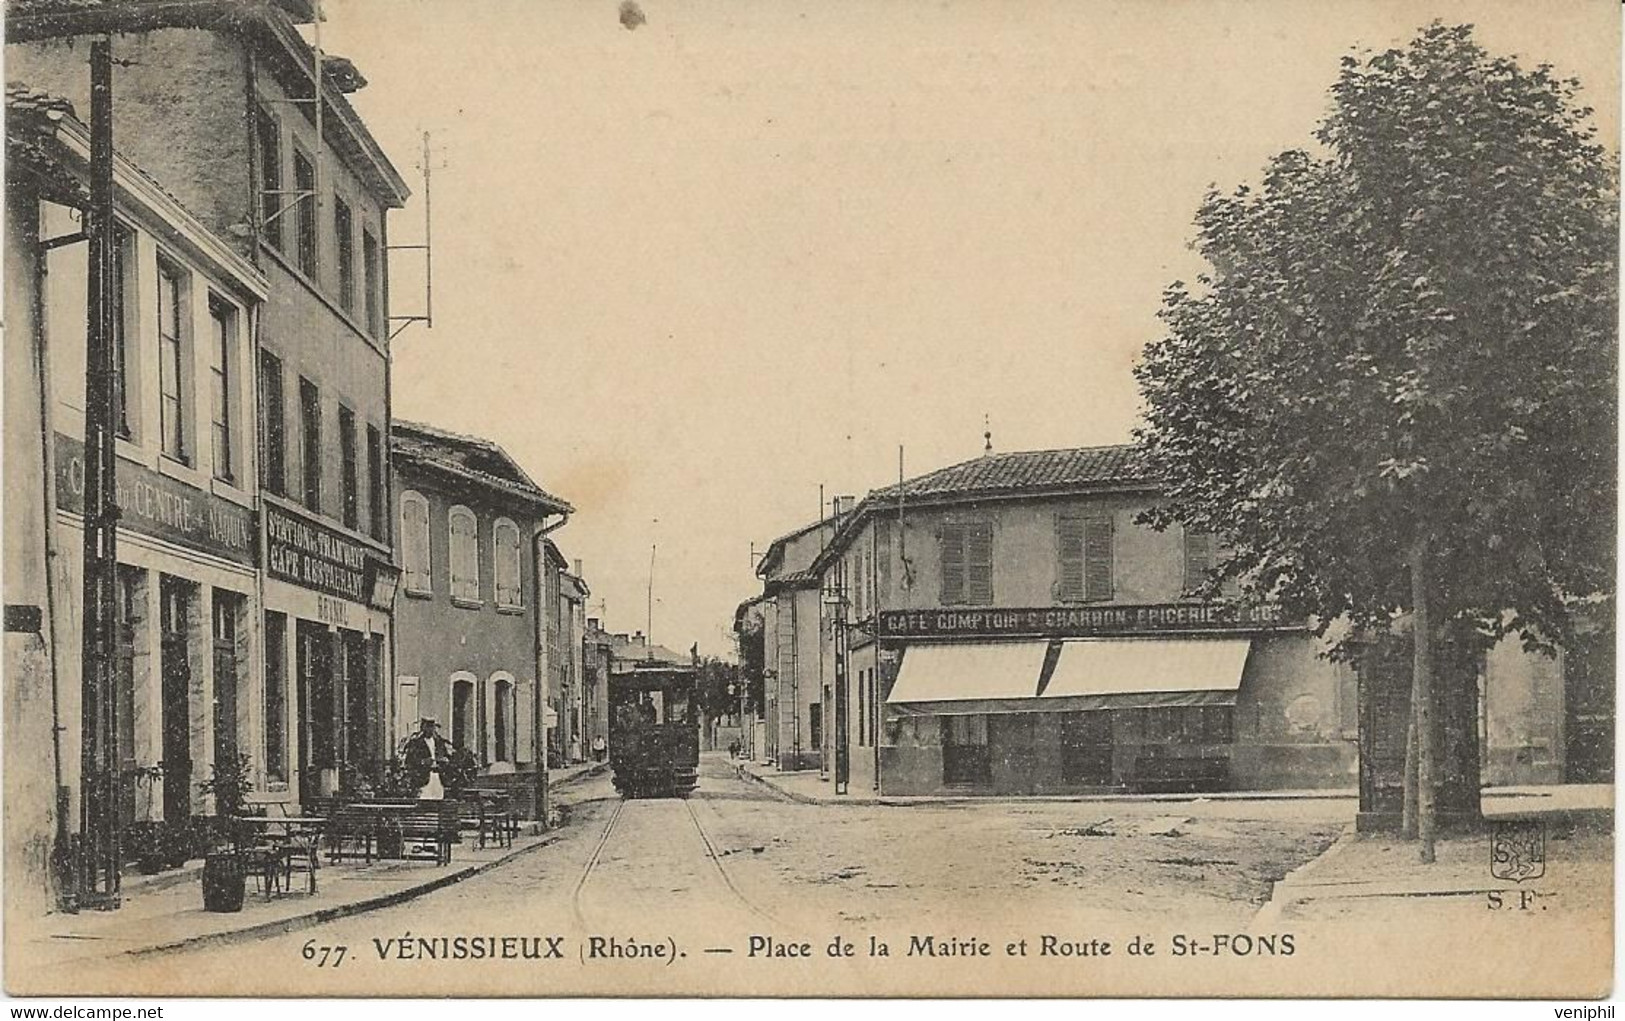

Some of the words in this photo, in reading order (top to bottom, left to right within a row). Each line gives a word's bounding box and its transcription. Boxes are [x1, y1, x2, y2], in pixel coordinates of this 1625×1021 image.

[135, 480, 192, 535] CENTRE
[268, 511, 310, 552] STATION
[1137, 607, 1216, 624] EPICERIE
